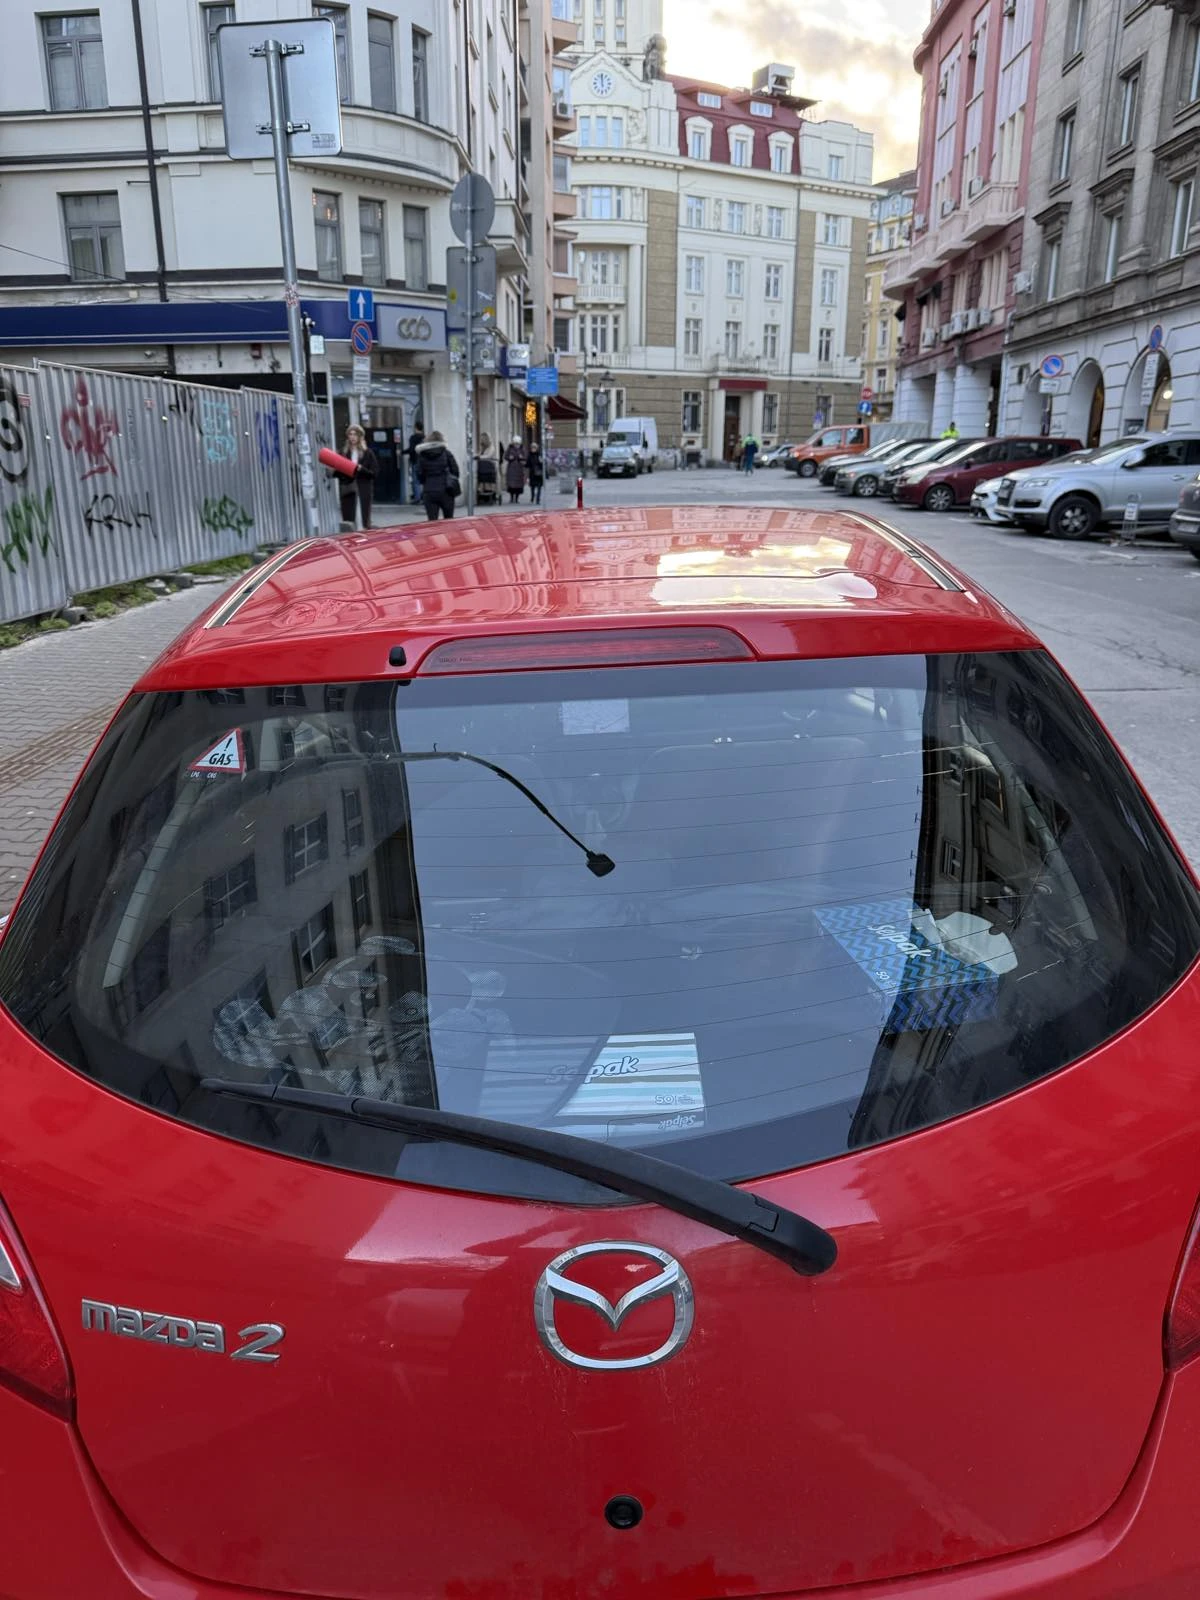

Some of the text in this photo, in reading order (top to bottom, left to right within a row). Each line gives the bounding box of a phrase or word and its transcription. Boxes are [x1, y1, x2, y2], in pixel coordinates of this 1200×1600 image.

[208, 753, 234, 765] GAS
[867, 924, 932, 959] Selpak
[545, 1056, 640, 1085] Sepak
[654, 1094, 675, 1105] 50
[230, 1322, 285, 1363] 2
